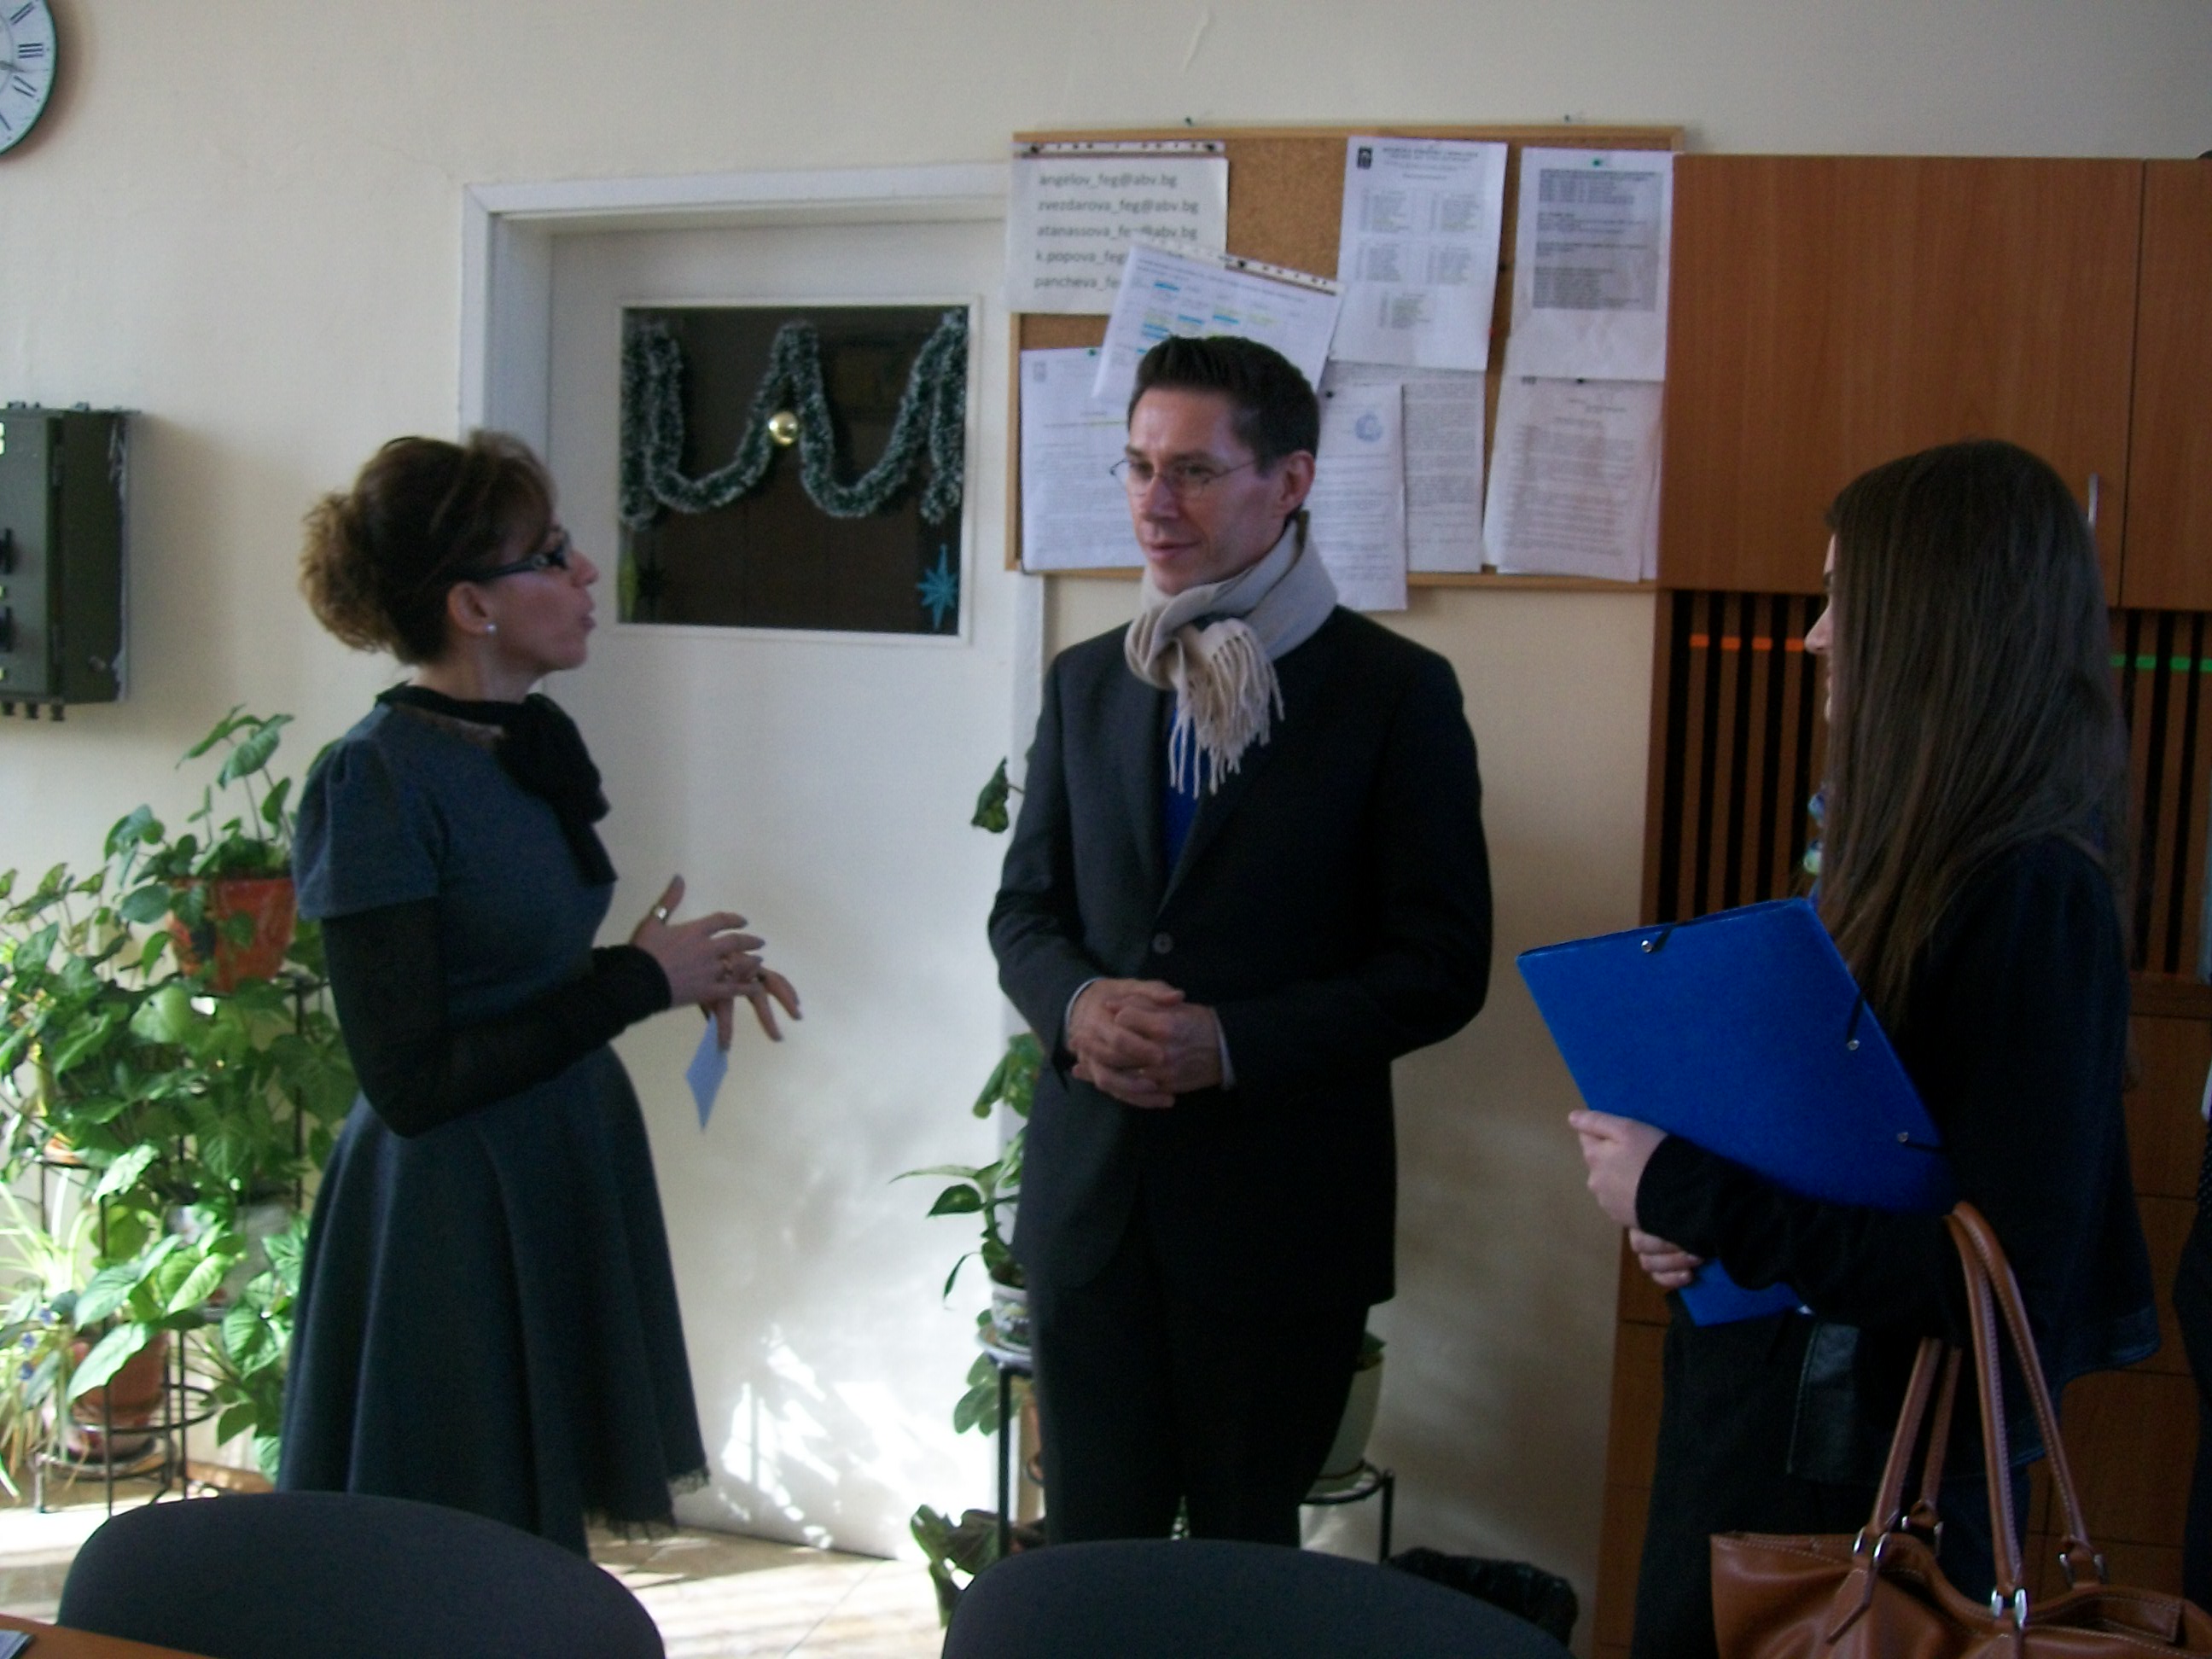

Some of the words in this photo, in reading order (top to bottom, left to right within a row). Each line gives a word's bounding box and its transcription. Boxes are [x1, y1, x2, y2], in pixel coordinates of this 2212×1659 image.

[1037, 224, 1198, 241] atanassova_fe@abv.bg
[1035, 249, 1127, 265] k.popova_feg
[1034, 275, 1121, 292] pancheva_fe
